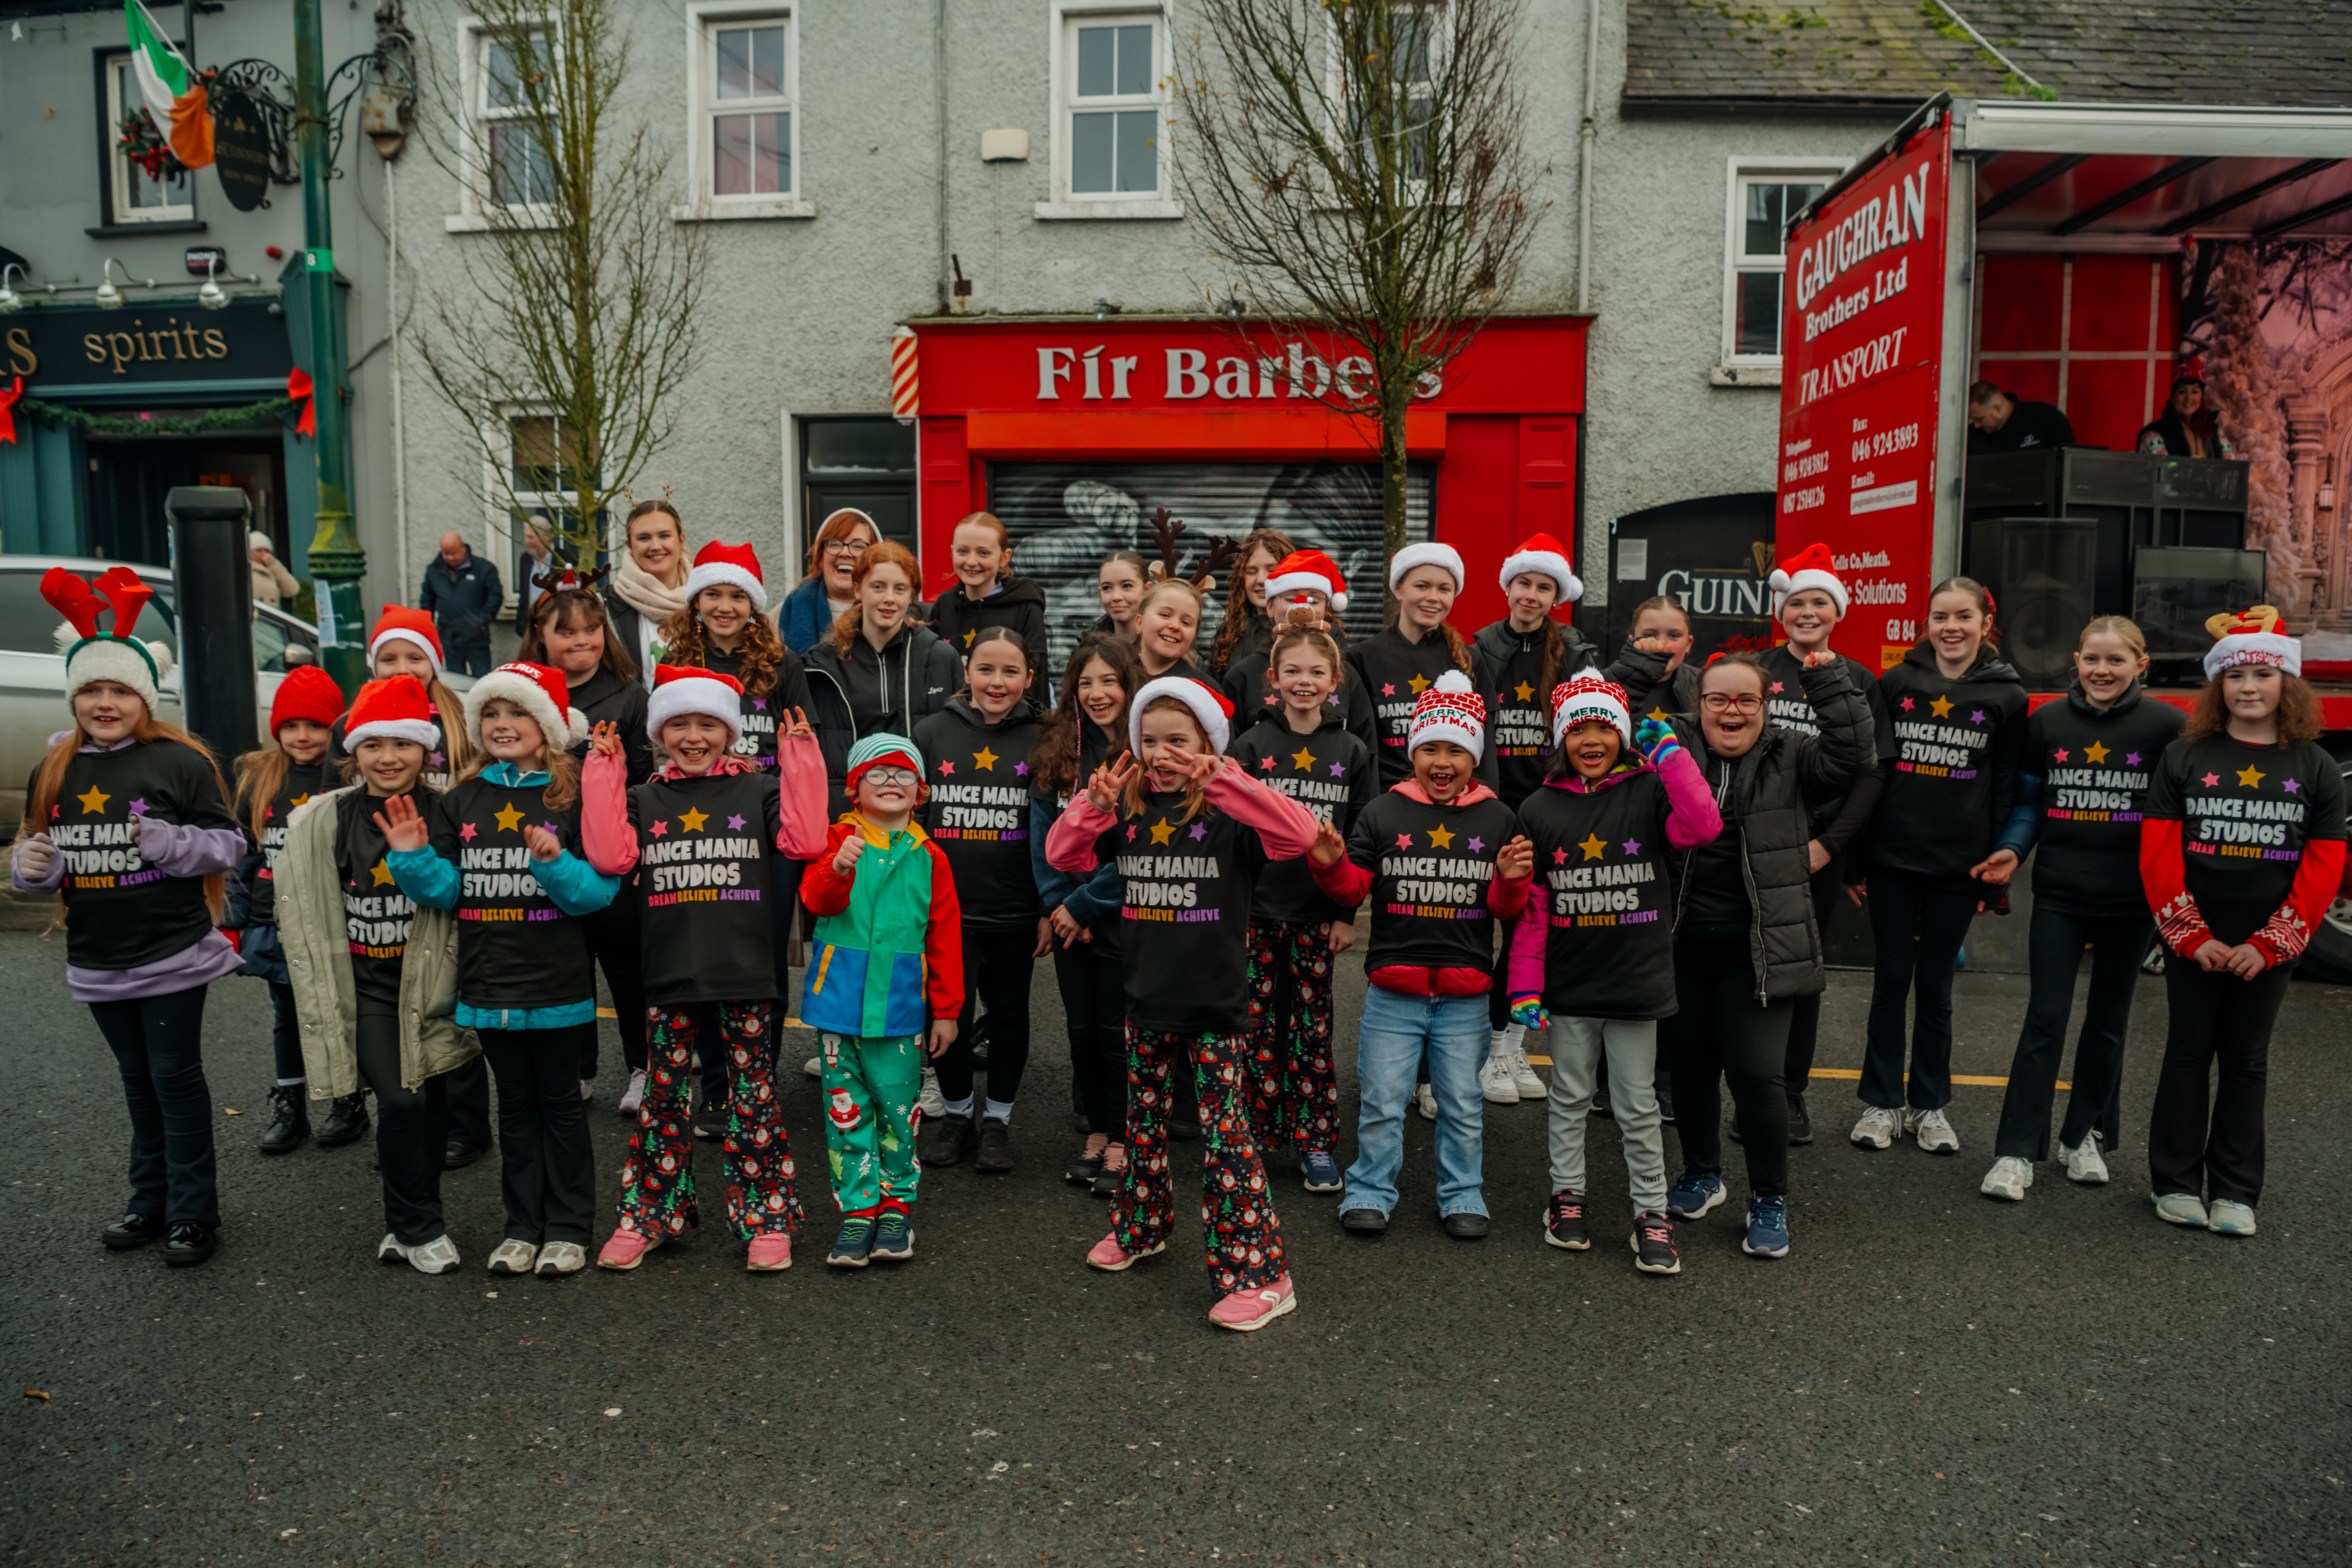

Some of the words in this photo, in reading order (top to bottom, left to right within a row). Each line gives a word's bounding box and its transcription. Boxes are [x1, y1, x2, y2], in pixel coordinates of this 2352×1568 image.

[1797, 161, 1930, 312] GAUGHRAN
[307, 253, 316, 266] 8
[1806, 286, 1869, 343] Brothers
[1874, 256, 1908, 304] Ltd
[0, 328, 37, 376] S
[84, 317, 228, 374] spirits
[1036, 344, 1138, 400] Fír
[1163, 342, 1443, 400] Barbes
[1800, 326, 1908, 406] TRANSPORT
[1853, 418, 1868, 433] Fax:
[1851, 436, 1870, 463] 046
[1873, 422, 1918, 457] 9243893
[1785, 461, 1798, 483] 046
[1851, 471, 1875, 489] Email:
[1783, 492, 1796, 514] 087
[1855, 577, 1907, 605] Solutions
[1886, 618, 1900, 641] GB
[1902, 619, 1915, 642] 84
[500, 663, 542, 679] CLAUS
[1419, 708, 1467, 722] MERRY
[1494, 710, 1524, 725] ANCE
[1570, 706, 1618, 722] MERRY
[1768, 700, 1807, 721] ANCE
[740, 714, 775, 734] ANIA
[1409, 715, 1477, 740] CHRISTMAS
[1937, 725, 1989, 749] MANIA
[1901, 741, 1970, 768] STUDIOS
[1915, 763, 1949, 777] BELIEVE
[2094, 770, 2148, 789] MANIA
[931, 784, 981, 804] DANCE
[982, 786, 1029, 807] MANI
[1260, 778, 1299, 796] ANCE
[1299, 780, 1350, 803] MANIA
[2056, 788, 2133, 811] STUDIOS
[942, 805, 1019, 830] STUDIOS
[2047, 808, 2072, 820] DREAM
[2072, 809, 2110, 822] BELIEVE
[2111, 811, 2144, 822] ACHIEV
[2186, 797, 2244, 819] DANCE
[2244, 800, 2305, 823] MANIA
[933, 828, 960, 840] DREAM
[962, 829, 998, 841] BELIEVE
[2200, 818, 2287, 846] STUDIOS
[461, 848, 502, 870] ANCE
[696, 838, 760, 859] MANIA
[2221, 844, 2262, 859] BELIEVE
[653, 862, 741, 892] STUDIOS
[1155, 856, 1220, 878] MANIA
[1382, 856, 1436, 877] DANCE
[1439, 859, 1494, 881] MANIA
[1594, 862, 1656, 887] MANIA
[75, 875, 115, 888] BELIEVE
[1396, 879, 1477, 905] STUDIOS
[648, 892, 677, 907] DREAM
[677, 889, 718, 903] BELIEVE
[720, 889, 760, 901] ACHIEVE
[1125, 880, 1197, 907] STUDIOS
[1556, 887, 1640, 915] STUDIOS
[346, 893, 382, 918] ANCE
[482, 909, 524, 921] BELIEVE
[1138, 907, 1174, 922] BELIEVE
[1176, 909, 1220, 922] ACHIEVE
[1387, 903, 1414, 916] DREAM
[1416, 905, 1456, 919] BELIEVE
[1577, 914, 1617, 927] BELIEVE
[1619, 910, 1658, 925] ACHIEVE
[348, 917, 413, 945] STUDIO
[366, 944, 406, 959] BELIEV
[1640, 1173, 1662, 1183] TnnT
